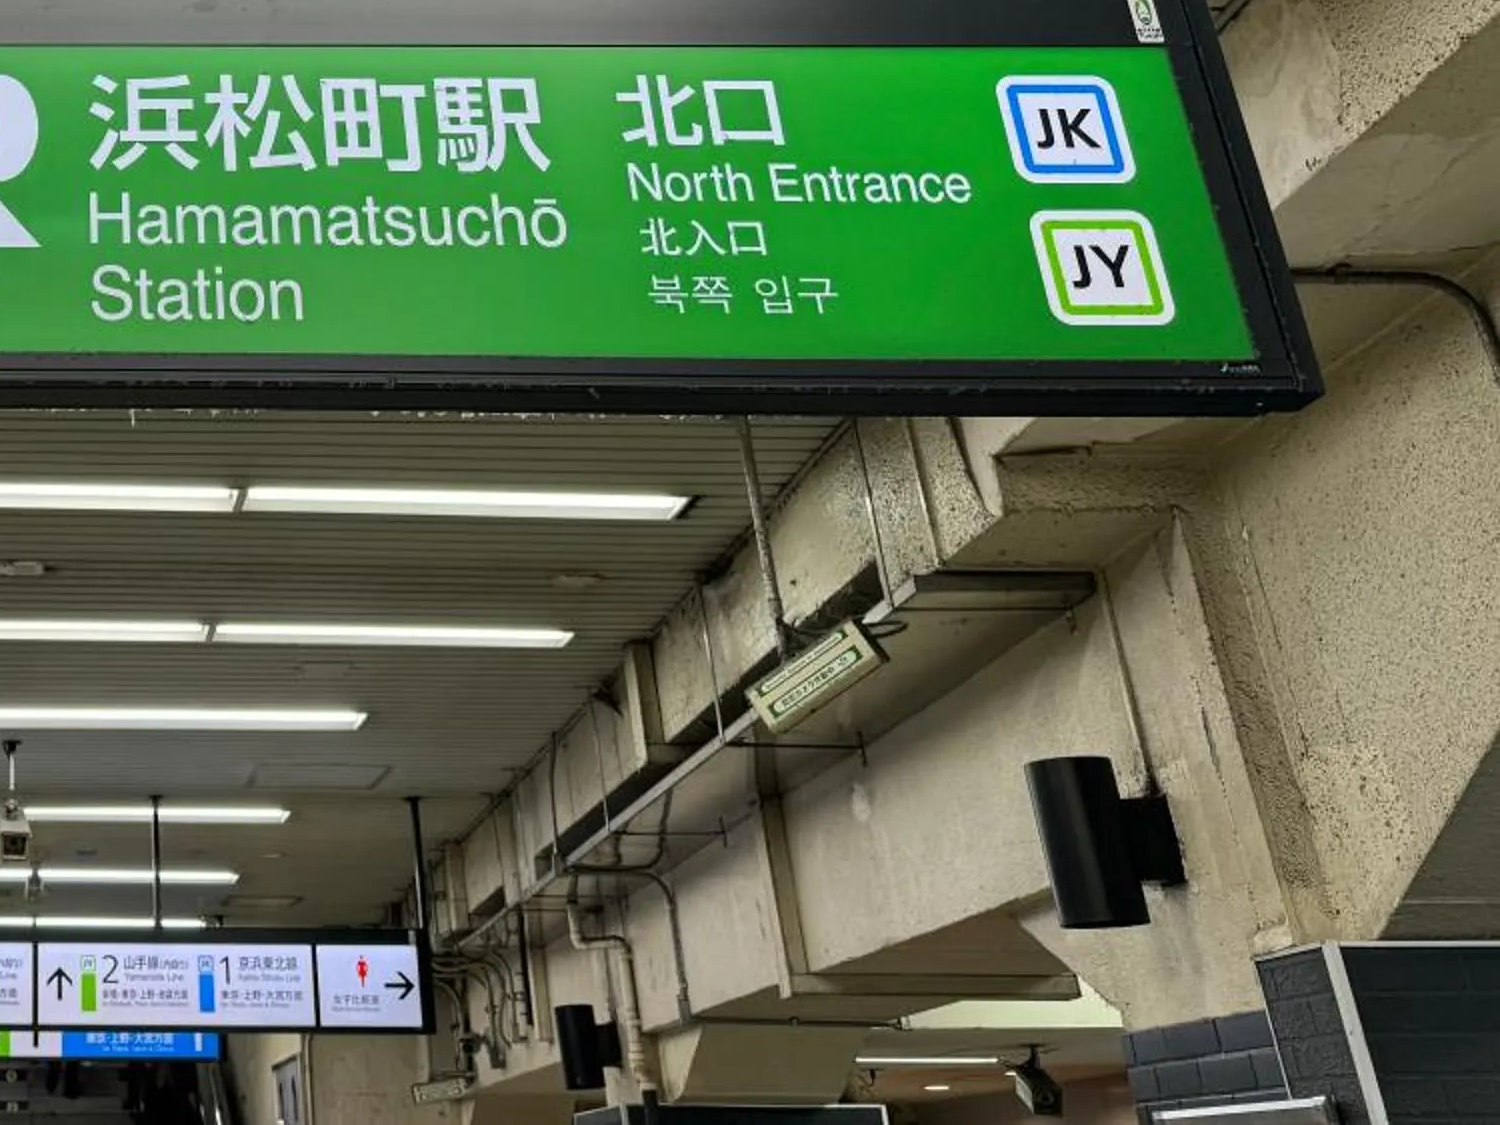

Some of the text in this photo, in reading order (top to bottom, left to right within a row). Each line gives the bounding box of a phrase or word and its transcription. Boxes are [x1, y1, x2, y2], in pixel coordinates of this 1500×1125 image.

[88, 73, 551, 173] 浜松町駅
[615, 74, 786, 147] 北口
[1035, 107, 1102, 150] JK
[627, 162, 973, 204] North Entrance
[88, 191, 568, 249] Hamamatsuchō
[640, 218, 768, 258] 北入口
[1071, 243, 1130, 290] JY
[90, 264, 304, 323] Station
[646, 275, 839, 315] 북쪽 입구
[102, 954, 120, 984] 2
[219, 955, 232, 985] 1
